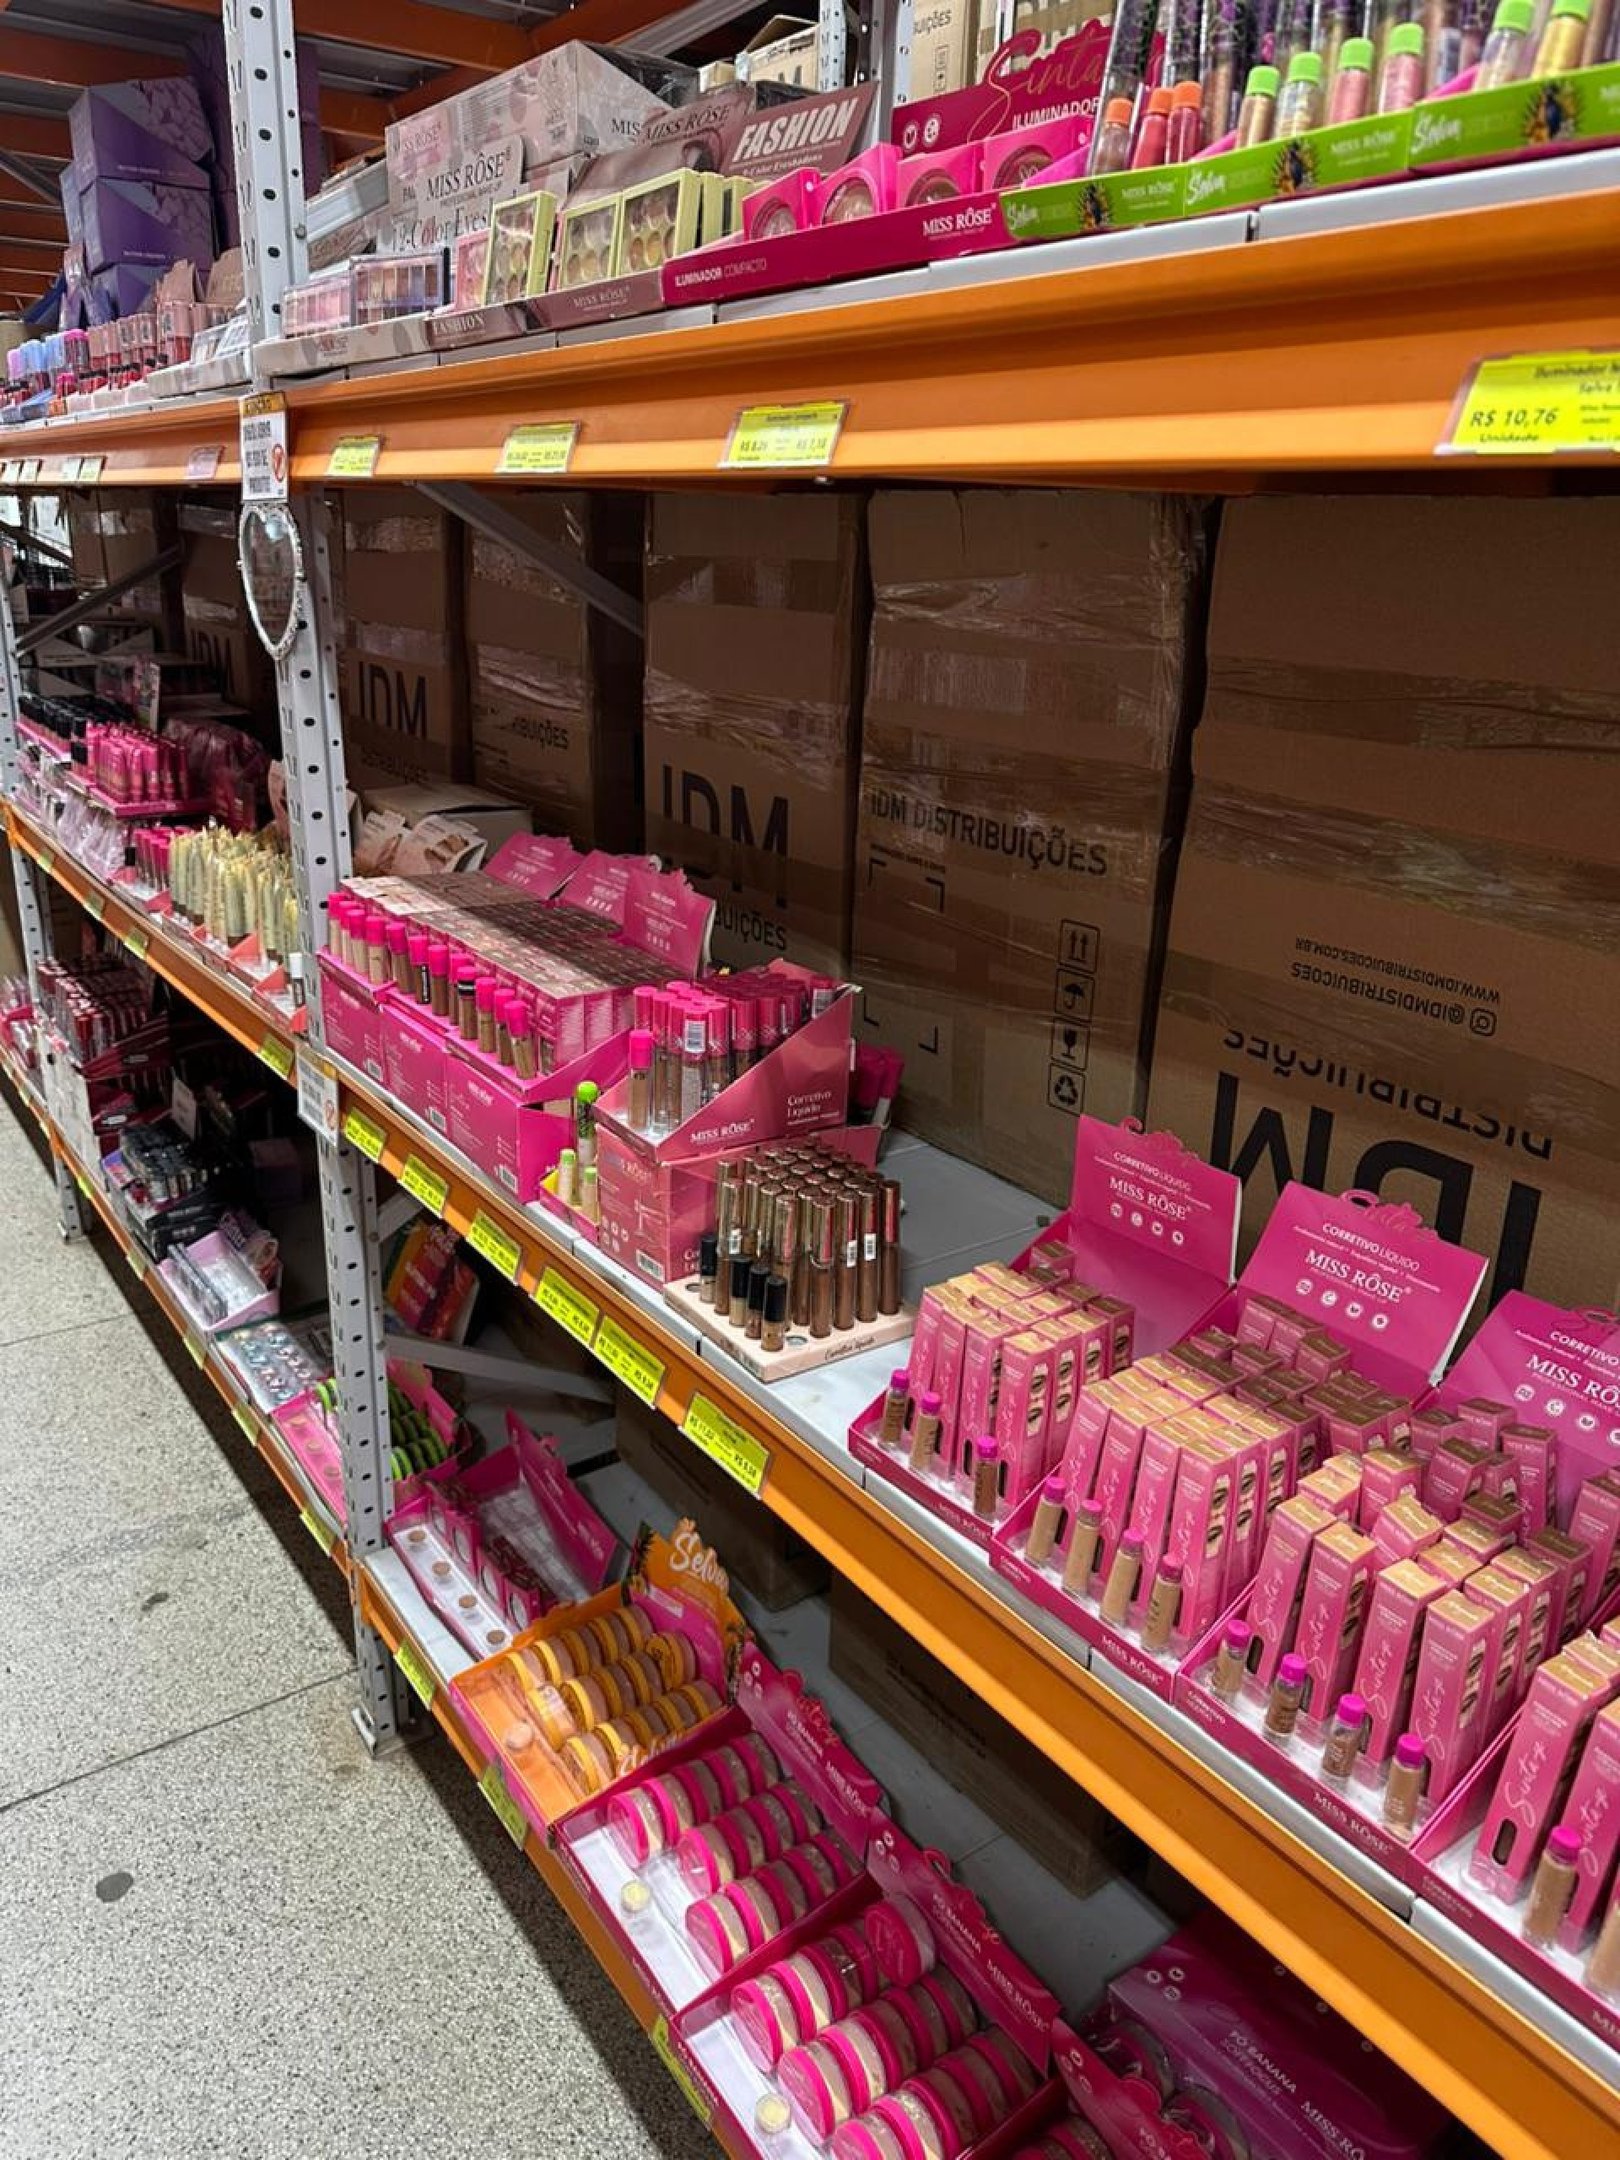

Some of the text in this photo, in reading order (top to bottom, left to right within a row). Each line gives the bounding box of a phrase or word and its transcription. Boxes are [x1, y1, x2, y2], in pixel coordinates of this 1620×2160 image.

[611, 117, 642, 137] MIS
[684, 103, 729, 131] RÔSE
[732, 98, 859, 163] FASHION
[427, 168, 461, 200] MISS
[464, 151, 504, 188] RÔSE
[922, 218, 953, 236] MISS
[956, 206, 992, 230] RÔSE
[675, 267, 722, 288] ILUMINADOR
[433, 312, 485, 335] FASHION
[1470, 410, 1496, 427] R$
[1504, 408, 1559, 429] 10,76
[358, 660, 428, 739] IDM
[662, 763, 789, 910] IDM
[872, 788, 906, 826] IDM
[914, 801, 1107, 876] DISTRIBUIÇÕES
[1291, 961, 1466, 1025] @IDMDISTRIBUICOES
[787, 1090, 832, 1107] Corretivo
[690, 1122, 750, 1143] MISS RÔSE
[1113, 1151, 1160, 1177] CORRETIVO
[1109, 1175, 1144, 1201] MISS
[1148, 1191, 1186, 1220] RÔSE
[1322, 1223, 1380, 1253] CORRETIVO
[1305, 1248, 1350, 1279] MISS
[1352, 1269, 1400, 1304] RÔSE
[1550, 1331, 1619, 1366] CORRETIVO
[1525, 1353, 1582, 1388] MISS
[1101, 1634, 1129, 1662] MISS
[1313, 1792, 1392, 1856] MISS RÔSE
[986, 1959, 1014, 1999] MISS
[1248, 2044, 1297, 2094] BANANA
[1300, 2100, 1340, 2140] MISS
